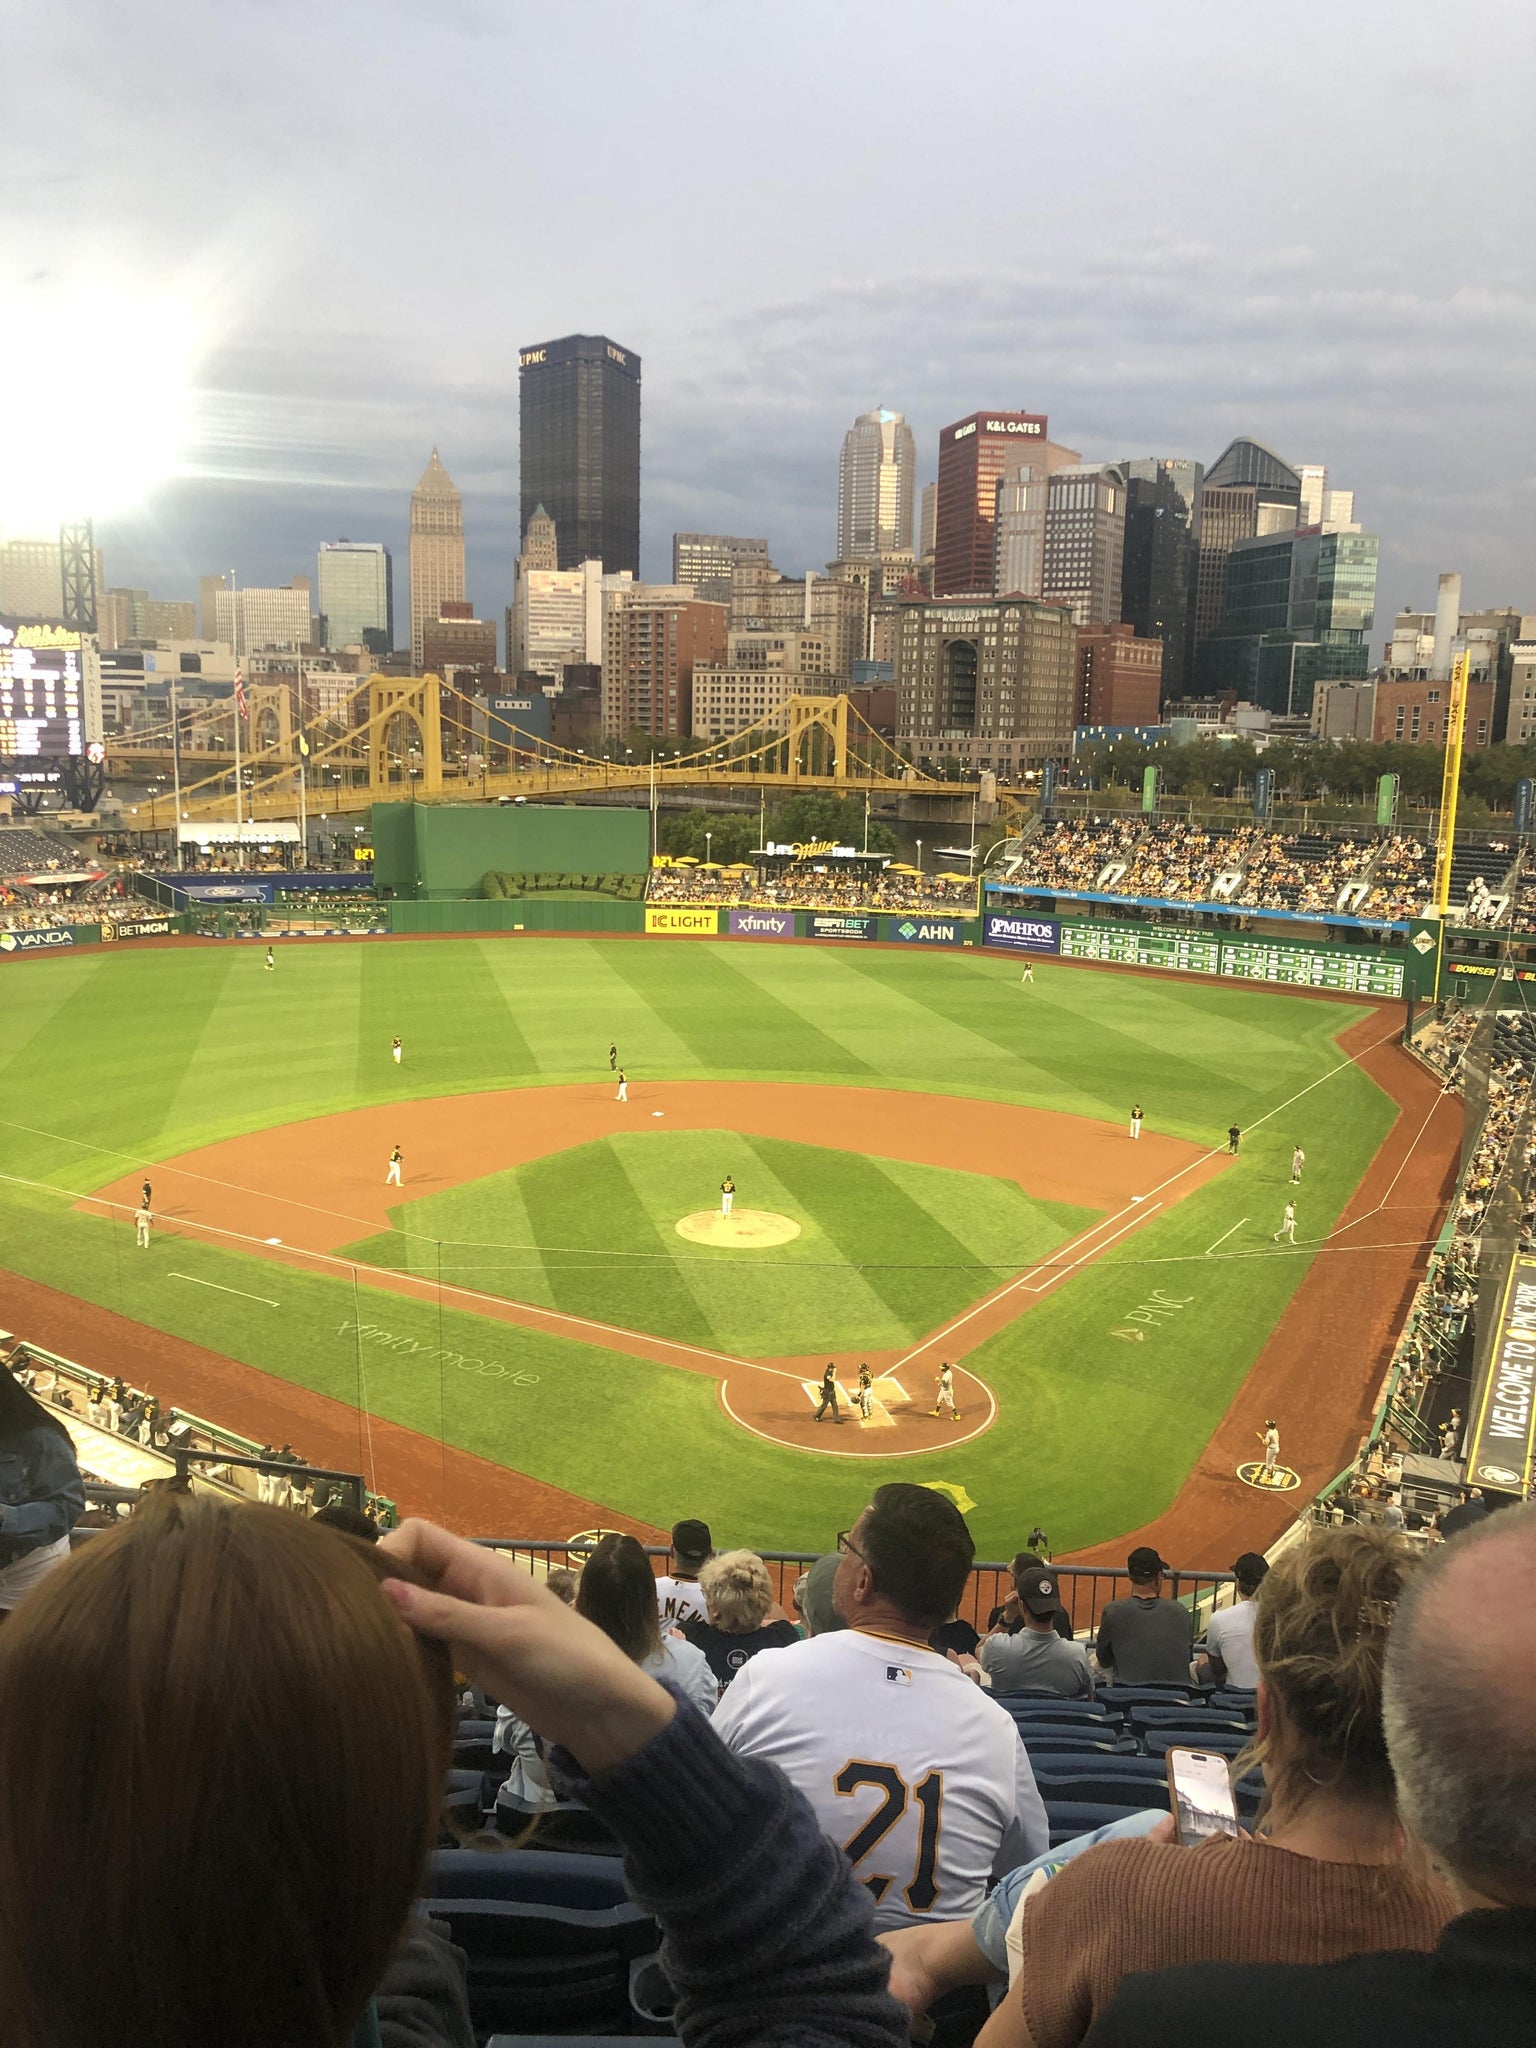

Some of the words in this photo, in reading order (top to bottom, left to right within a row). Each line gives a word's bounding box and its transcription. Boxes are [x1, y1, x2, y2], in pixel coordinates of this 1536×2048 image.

[519, 349, 547, 367] UPMC
[607, 345, 627, 366] UPMC
[986, 420, 1006, 432] K&L
[1007, 422, 1041, 434] GATES
[354, 848, 375, 860] 0:27
[792, 840, 840, 862] Miller
[500, 872, 646, 900] PIRATES
[119, 922, 169, 937] BETMGM
[652, 914, 668, 928] IC
[670, 916, 712, 928] LIGHT
[737, 915, 786, 934] xfinity
[814, 917, 846, 928] ESPN
[845, 919, 870, 929] BET
[16, 930, 74, 946] VANDA
[918, 925, 954, 941] AHN
[1455, 964, 1497, 977] BOWSER
[1124, 1289, 1195, 1326] PNC
[1510, 1306, 1536, 1331] PNC
[332, 1320, 433, 1355] xfinity
[430, 1349, 541, 1387] mobile
[1503, 1341, 1536, 1362] TO
[1489, 1360, 1535, 1440] WELCOME
[832, 1757, 944, 1914] 21
